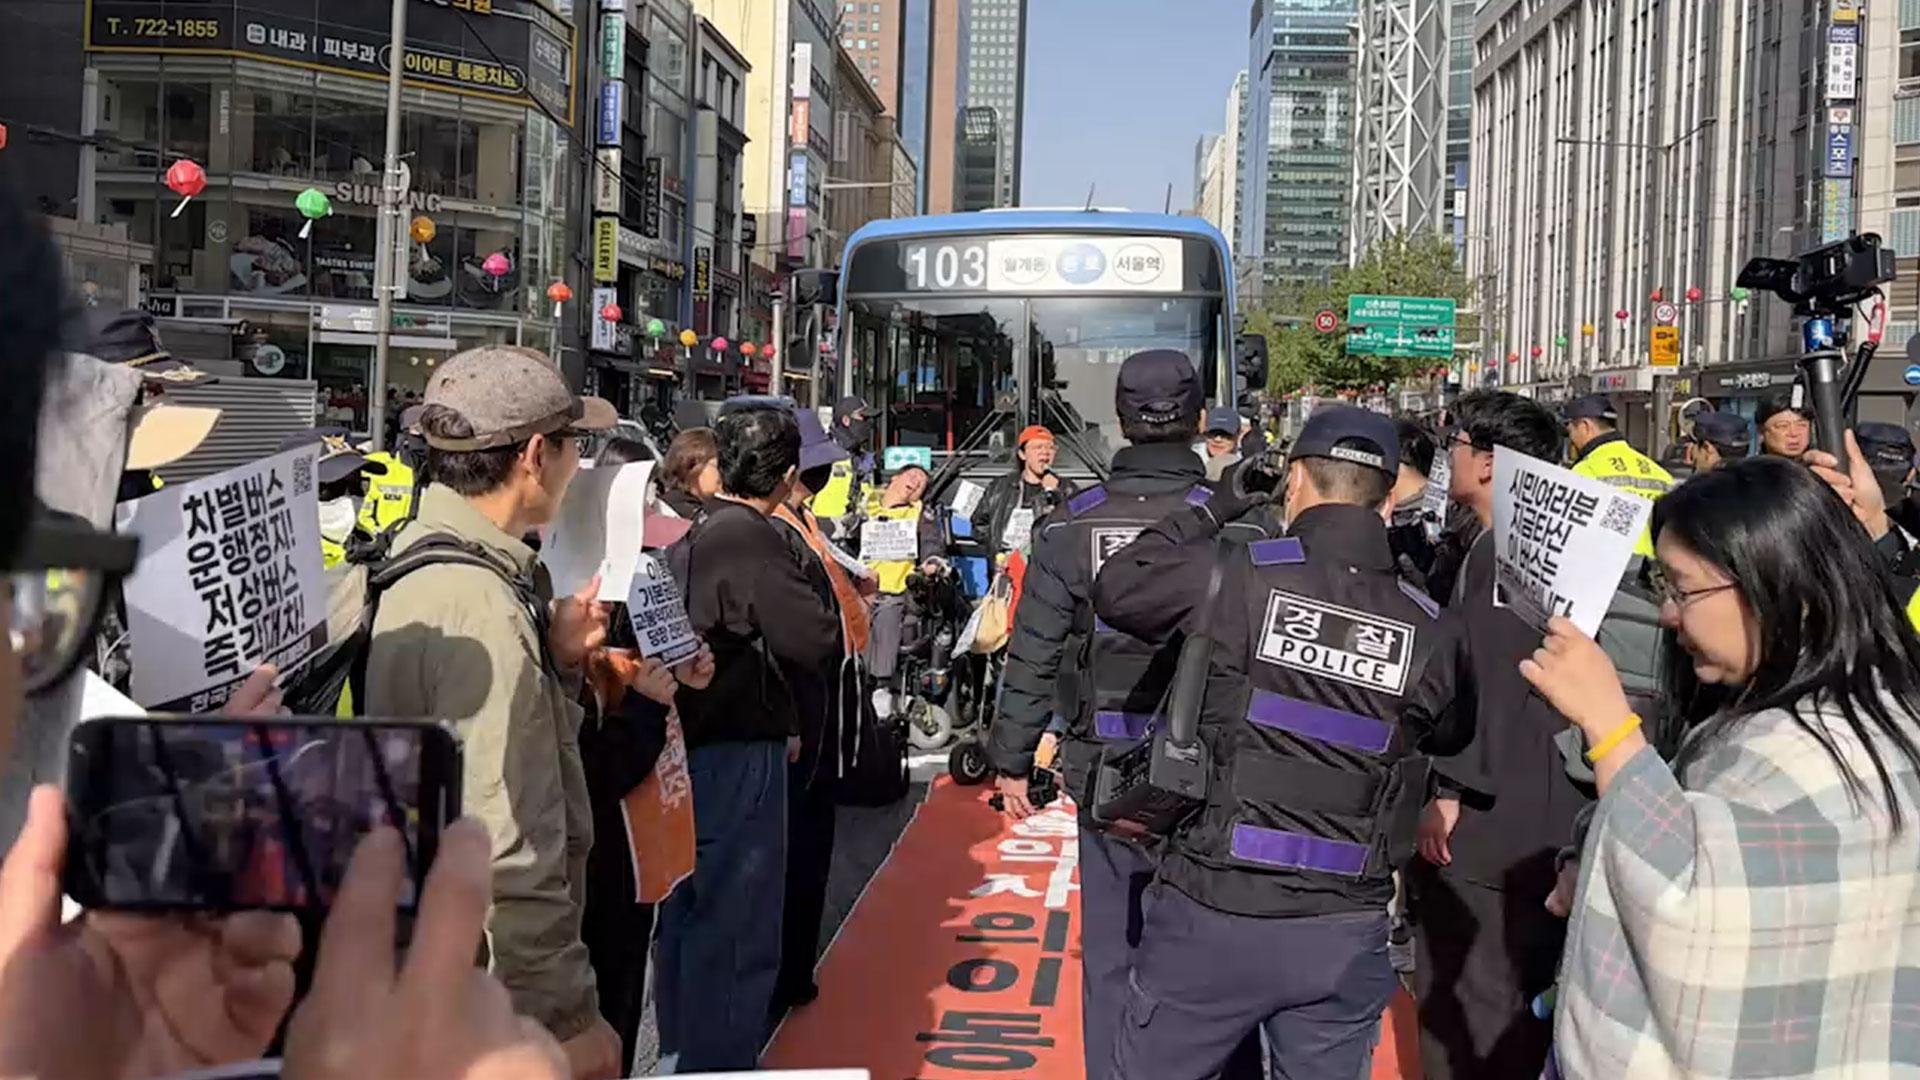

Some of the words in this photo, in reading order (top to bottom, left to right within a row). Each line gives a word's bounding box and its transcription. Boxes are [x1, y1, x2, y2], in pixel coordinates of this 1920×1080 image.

[107, 17, 128, 35] T.
[134, 18, 218, 38] 722-1855
[270, 29, 306, 51] 내과
[324, 38, 375, 64] 피부과
[402, 55, 453, 77] 이어트
[1831, 135, 1847, 173] 스포츠
[336, 182, 442, 212] SULNG
[599, 221, 612, 270] GALLERY
[910, 246, 985, 287] 103
[1116, 257, 1160, 272] 서울역
[1660, 308, 1672, 318] 50
[1140, 413, 1177, 423] POLICE
[1333, 448, 1380, 465] POLICE
[183, 468, 285, 539] 차별버스
[1509, 468, 1599, 527] 시민여러분
[187, 509, 297, 591] 운행정지!
[201, 554, 299, 634] 저상버스
[1280, 639, 1388, 683] POLICE
